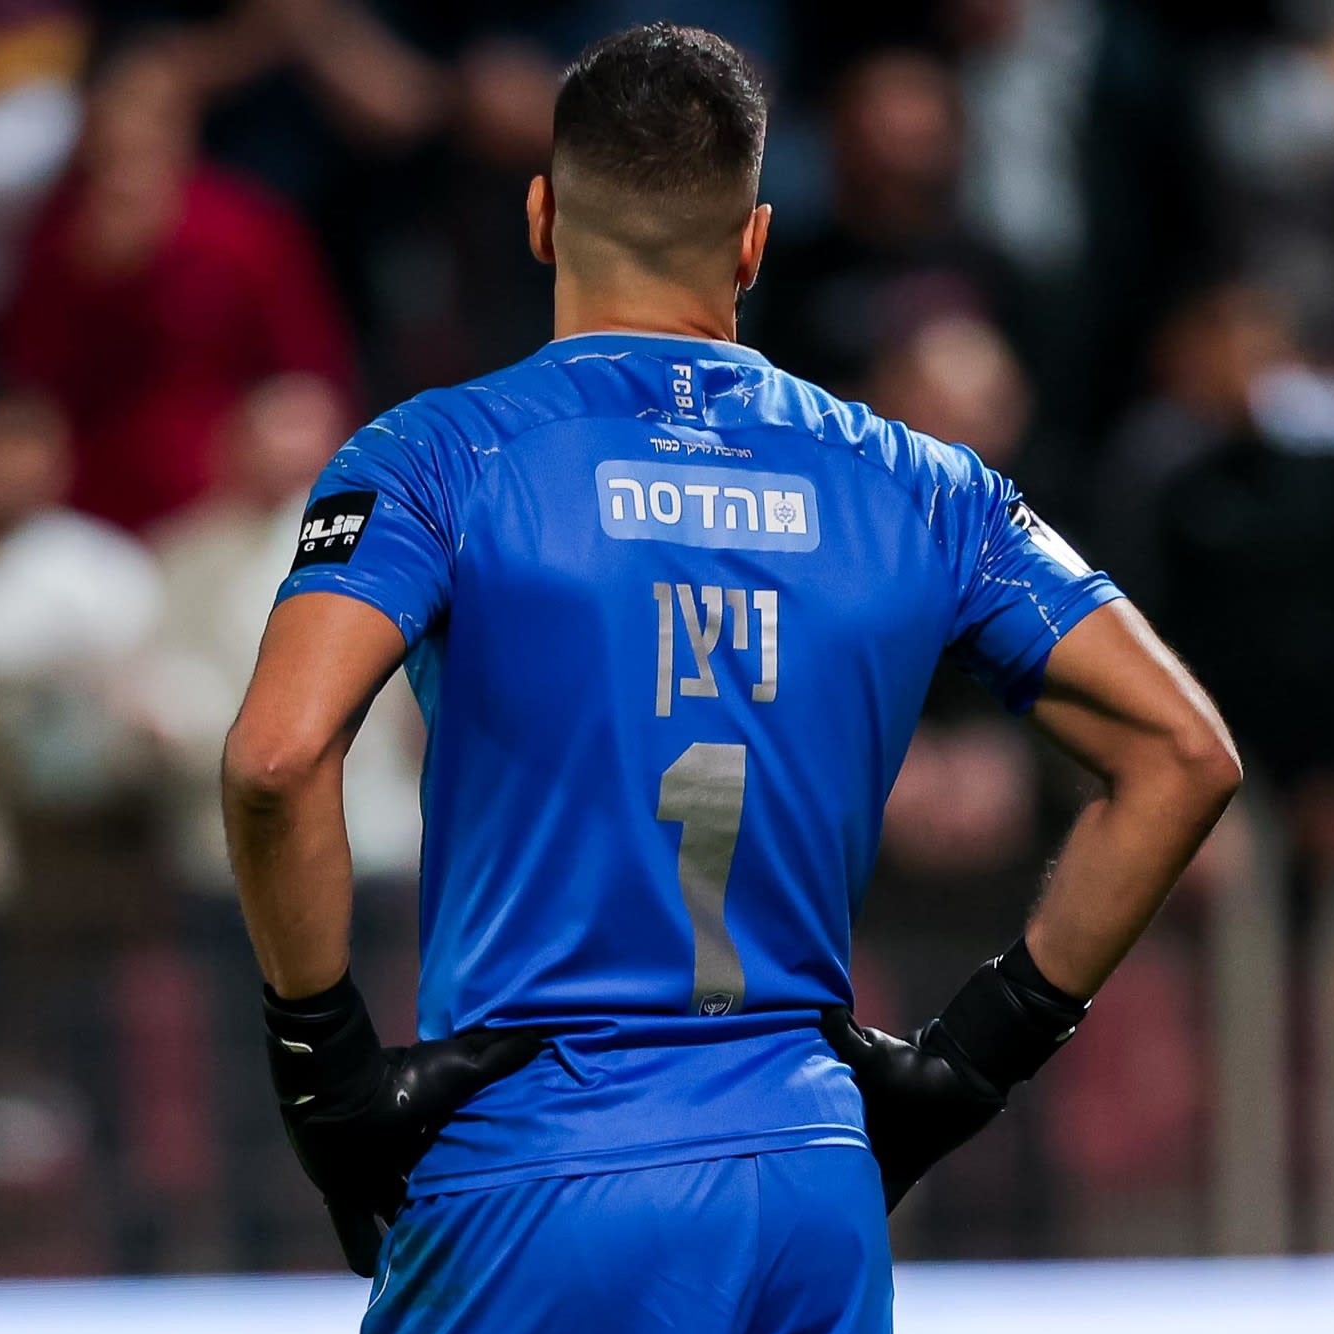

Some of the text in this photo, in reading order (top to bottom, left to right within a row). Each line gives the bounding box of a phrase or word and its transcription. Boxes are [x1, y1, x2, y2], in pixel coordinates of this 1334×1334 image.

[608, 478, 759, 532] הדסה
[653, 582, 778, 717] ניצן
[656, 741, 746, 1016] 1
